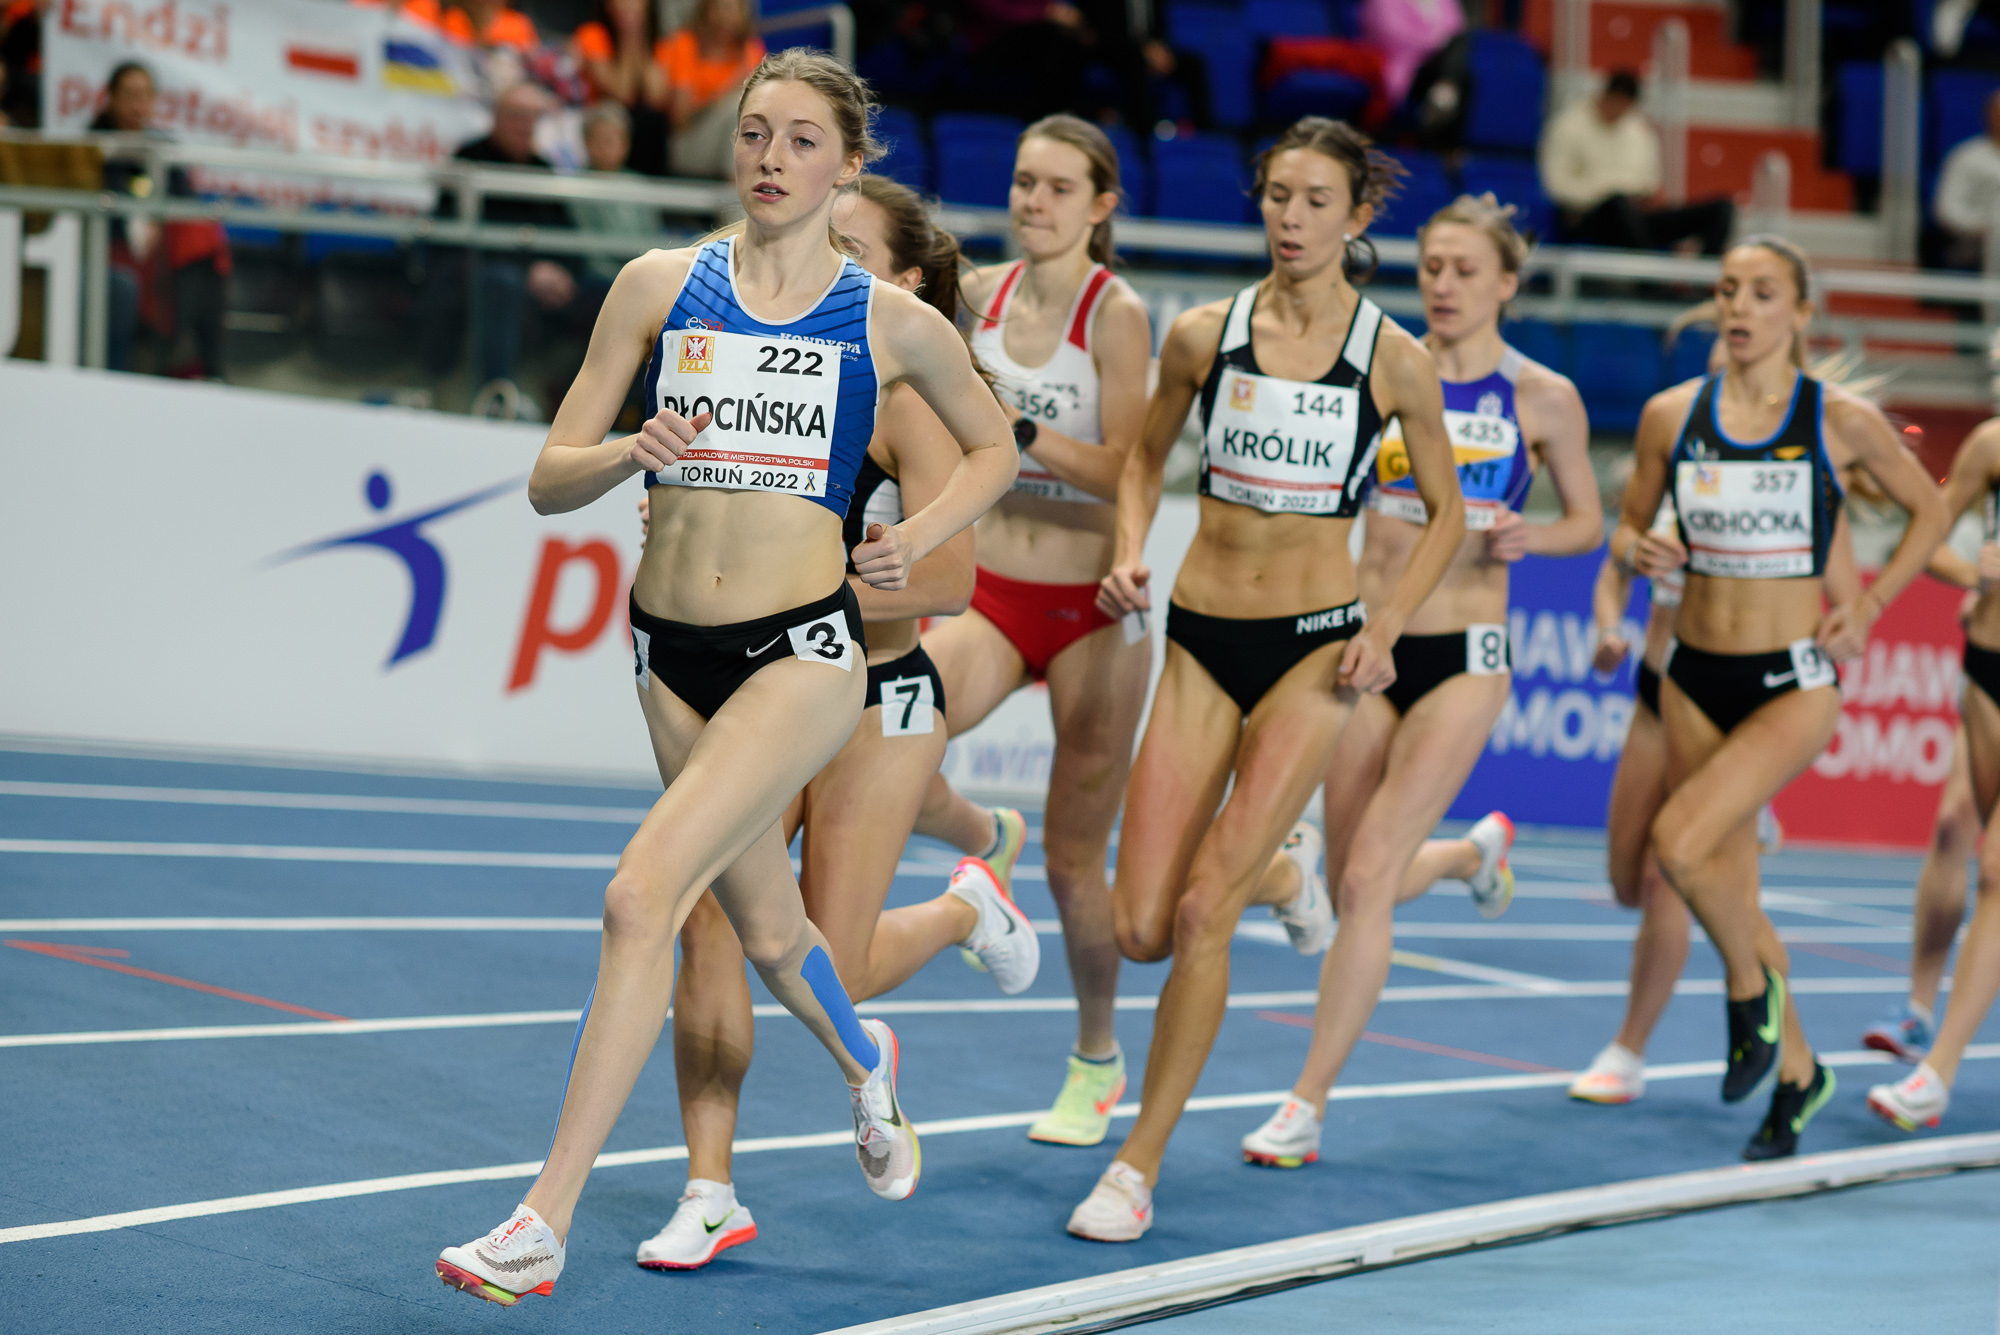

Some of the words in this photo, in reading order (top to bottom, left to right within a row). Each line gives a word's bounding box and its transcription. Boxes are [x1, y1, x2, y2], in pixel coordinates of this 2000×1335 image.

[680, 361, 710, 372] PZLA
[757, 346, 823, 376] 222
[664, 393, 827, 439] PŁOCIŃSKA
[1015, 389, 1058, 420] 356
[1293, 391, 1344, 420] 144
[1458, 421, 1503, 444] 435
[683, 451, 698, 459] PZLA
[699, 452, 729, 460] HALOWE
[730, 454, 788, 466] MISTRZOSTWA
[788, 458, 815, 467] POLSKI
[1223, 427, 1335, 468] KRÓLIK
[681, 464, 743, 485] TORUŃ
[749, 470, 799, 490] 2022
[1751, 469, 1798, 493] 357
[1228, 484, 1275, 506] TORUŃ
[1281, 494, 1318, 509] 2022
[1296, 608, 1345, 635] NIKE
[806, 621, 845, 660] 3
[1481, 631, 1501, 669] 8
[1802, 649, 1821, 679] 9
[895, 683, 921, 730] 7
